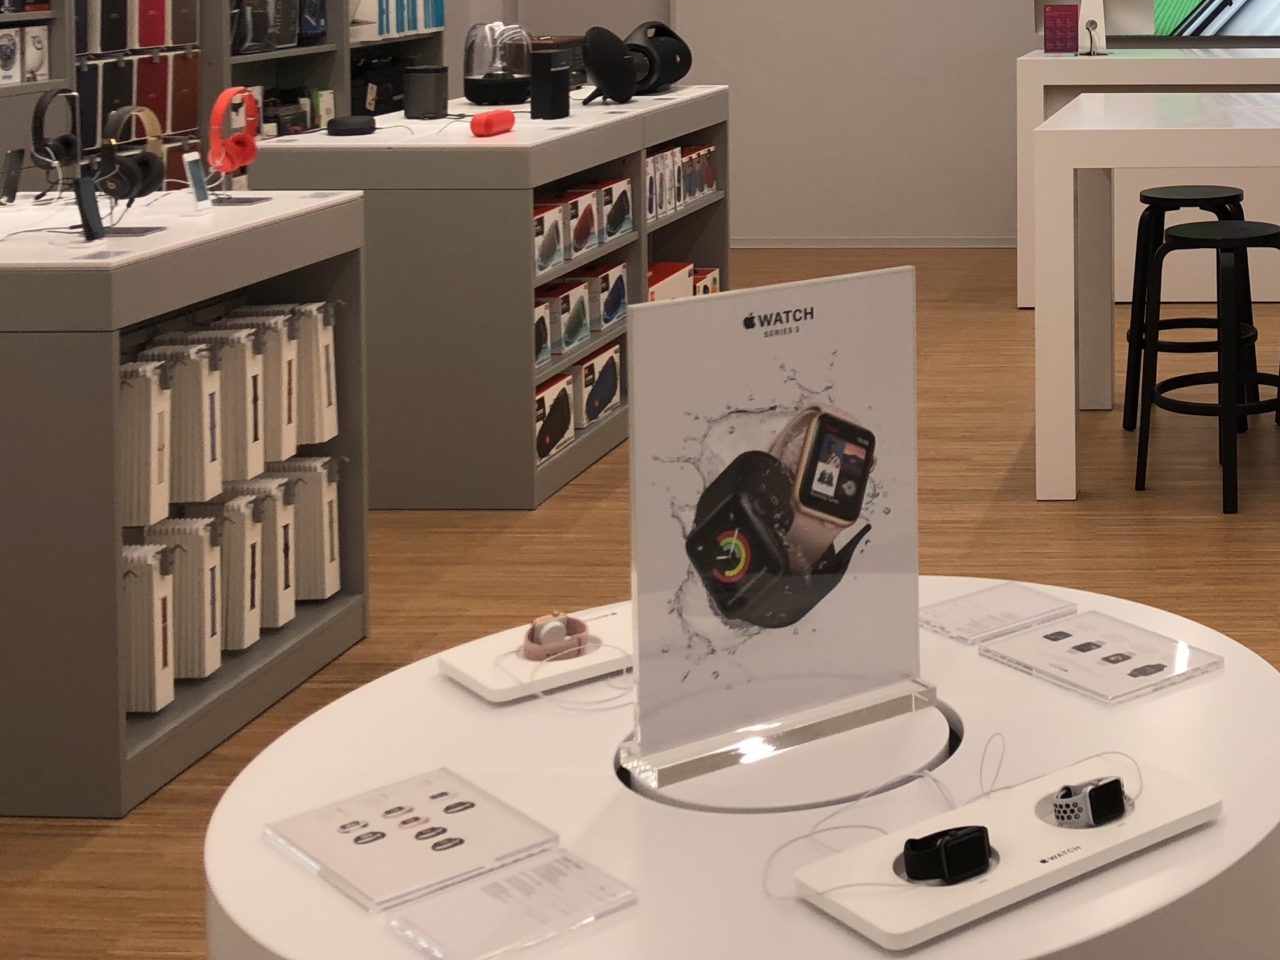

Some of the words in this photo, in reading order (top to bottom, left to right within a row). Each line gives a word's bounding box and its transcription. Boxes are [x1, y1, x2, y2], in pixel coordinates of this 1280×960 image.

[757, 306, 814, 327] WATCH
[764, 326, 793, 338] SERIES
[795, 326, 800, 334] 3
[1047, 845, 1082, 861] WATCH
